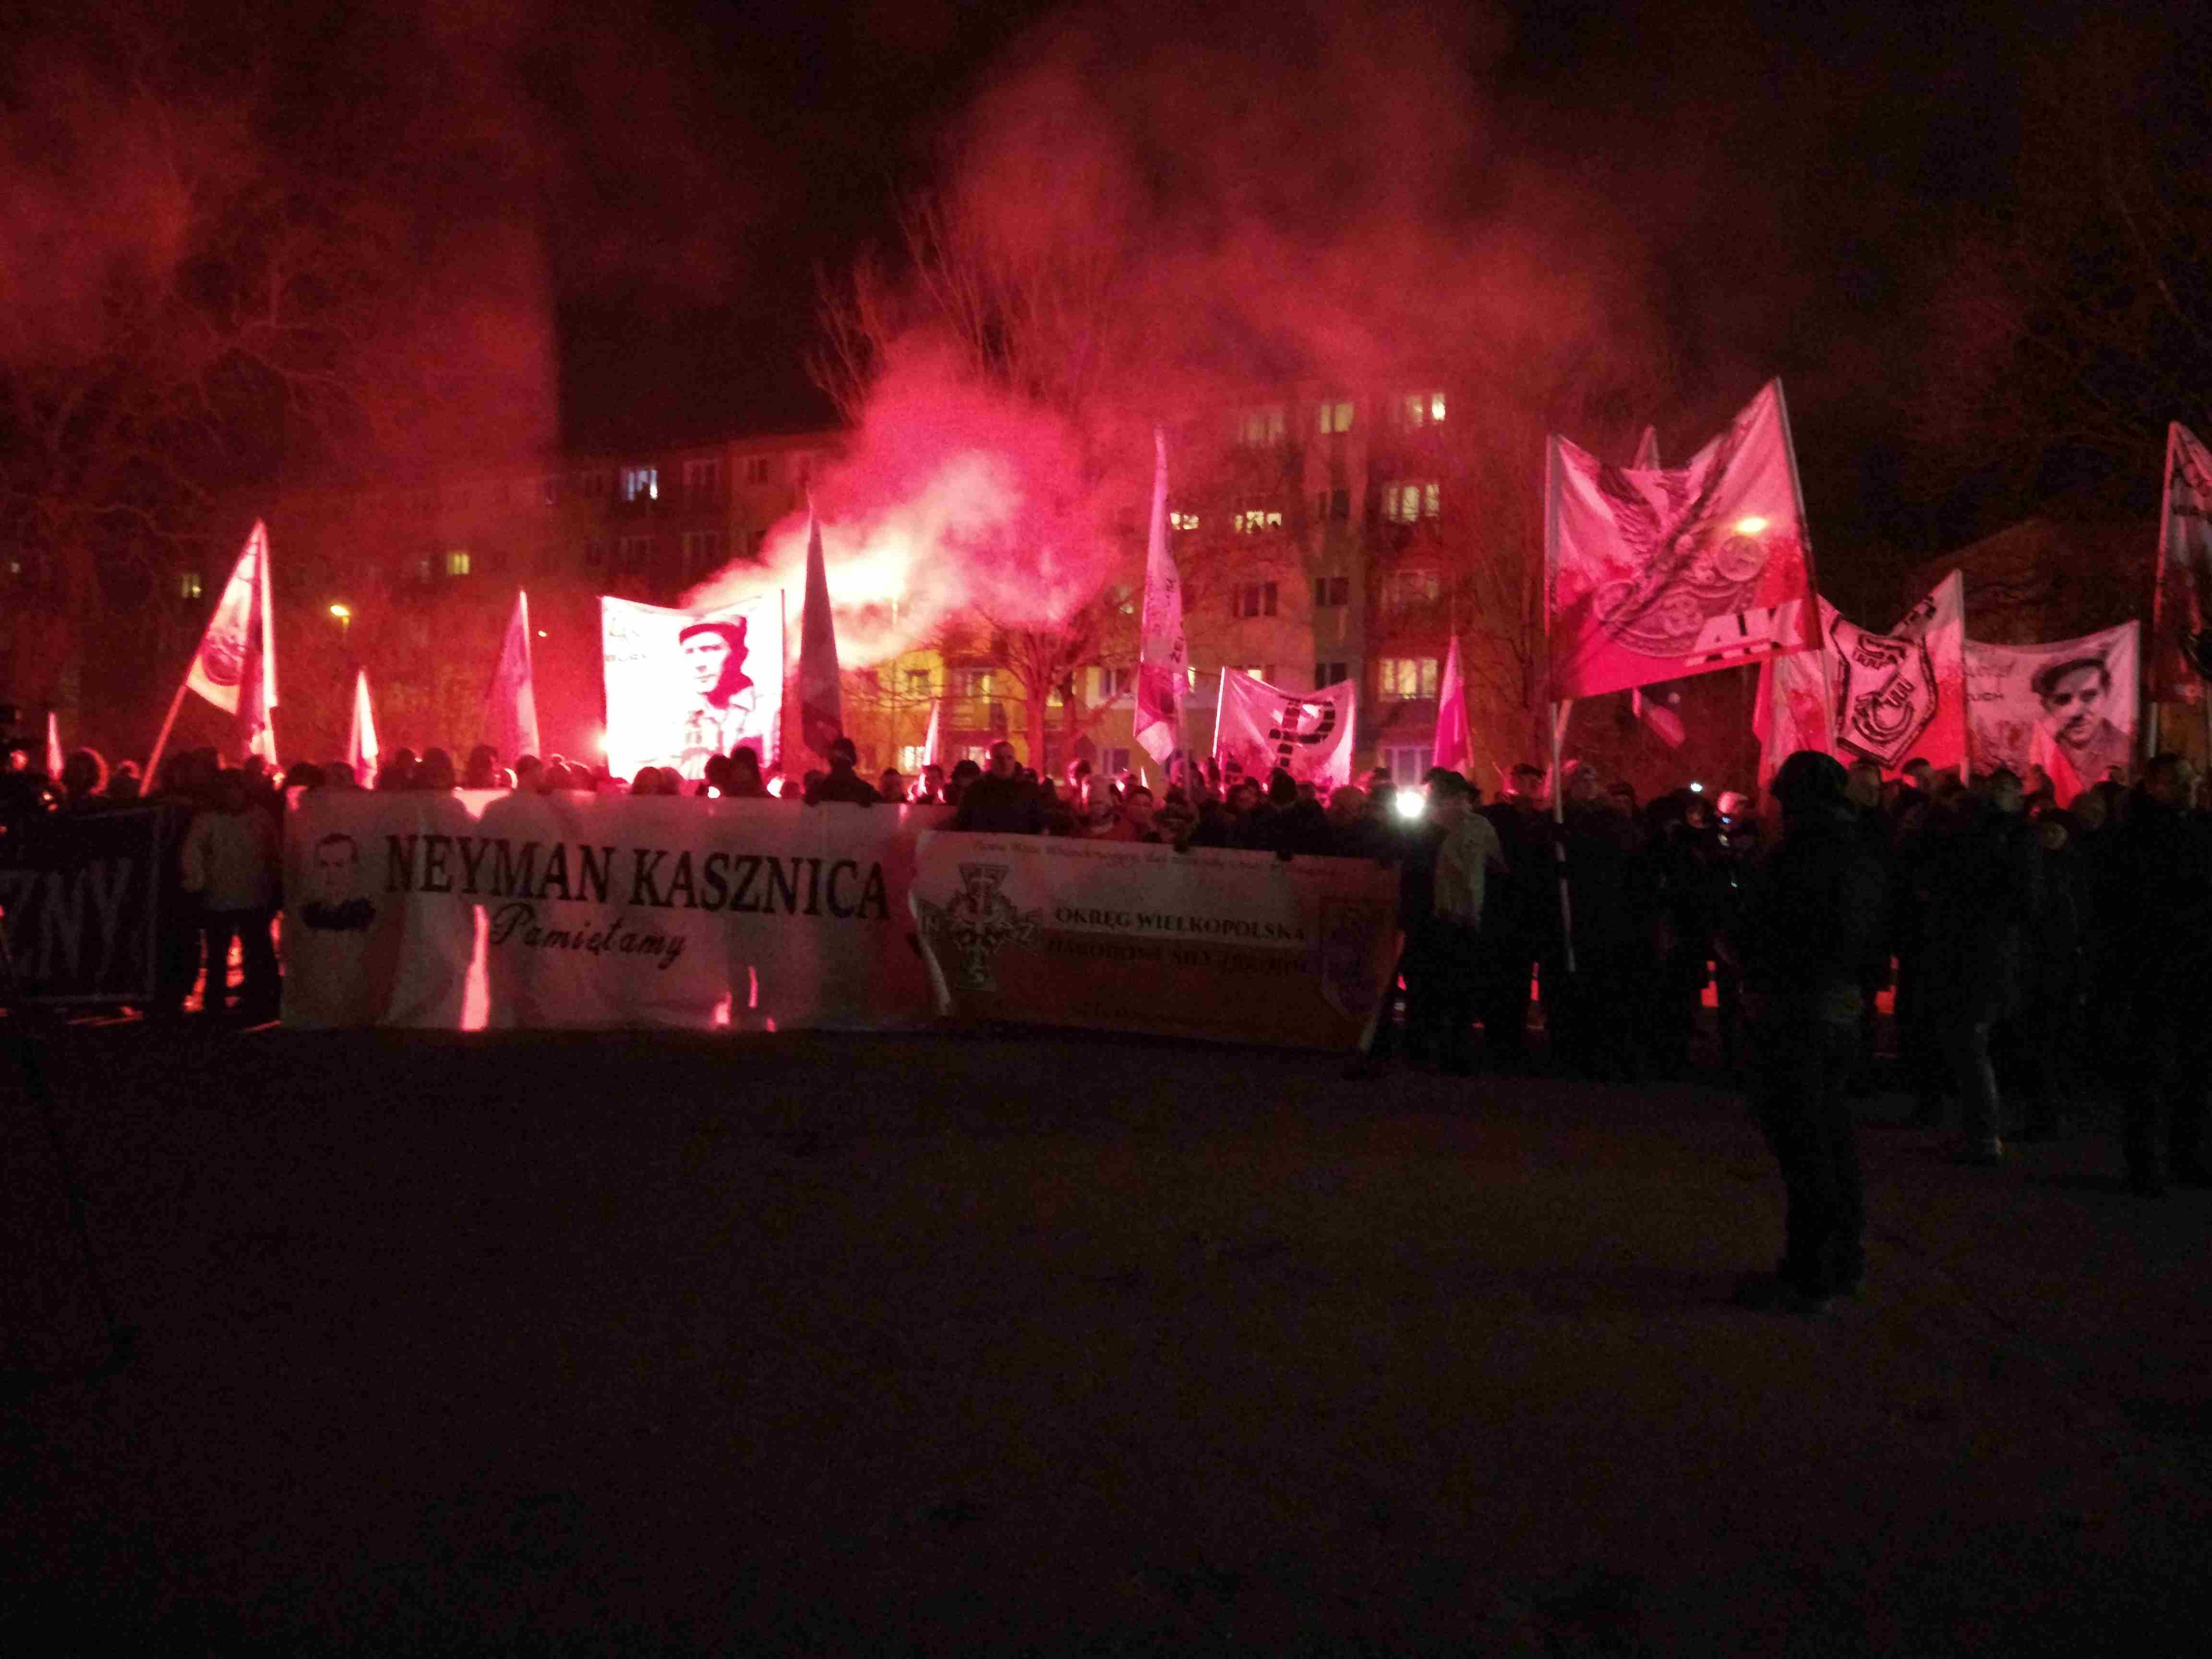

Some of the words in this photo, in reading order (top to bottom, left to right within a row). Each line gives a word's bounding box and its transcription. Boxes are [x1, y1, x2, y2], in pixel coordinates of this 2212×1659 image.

[386, 834, 615, 902] NEYMAN
[628, 848, 891, 920] KASZNICA
[1136, 913, 1304, 940] WIELKOPOLSKA
